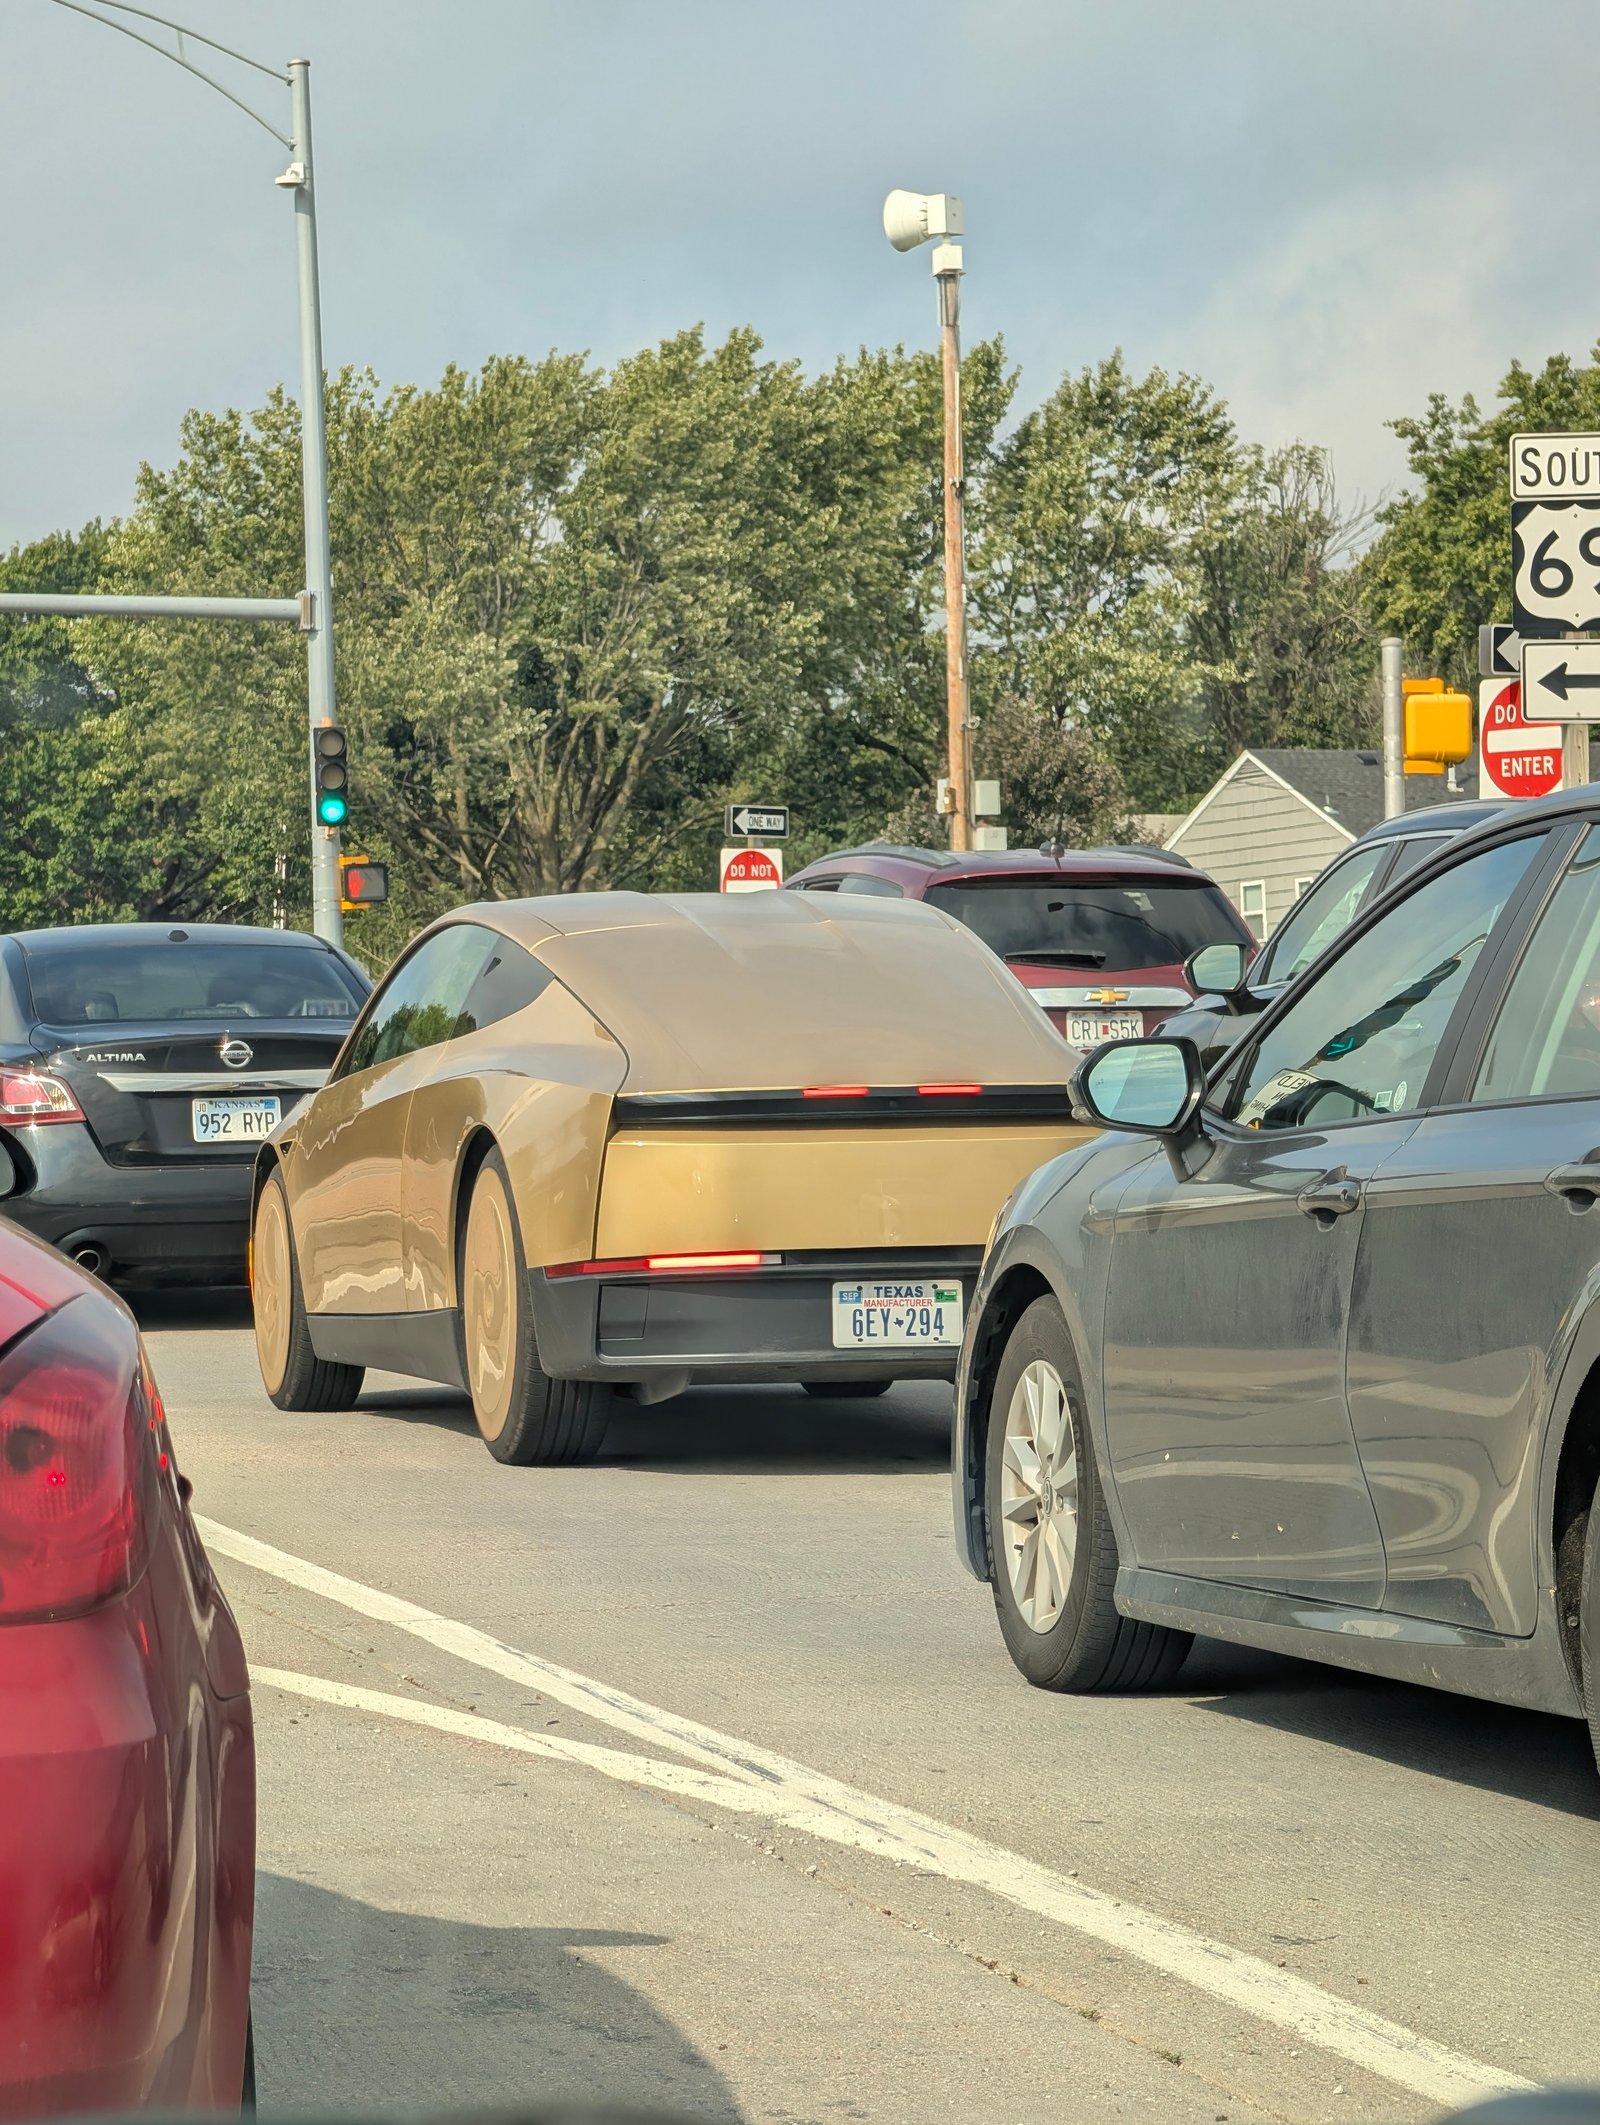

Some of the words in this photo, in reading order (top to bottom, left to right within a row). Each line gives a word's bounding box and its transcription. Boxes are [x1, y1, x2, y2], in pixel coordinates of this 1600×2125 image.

[1495, 704, 1517, 724] DO
[1501, 755, 1555, 778] ENTER
[748, 815, 764, 828] ONE
[766, 816, 782, 828] WAY
[730, 864, 746, 877] DO
[751, 864, 773, 877] NOT
[1110, 1019, 1139, 1040] S5K
[86, 1053, 147, 1063] ALTIMA
[214, 1100, 260, 1109] KANSAS
[200, 1113, 232, 1134] 952
[243, 1112, 275, 1133] RYP
[842, 1292, 859, 1301] SEP
[873, 1286, 924, 1298] TEXAS
[863, 1299, 933, 1307] MANUFACTURER
[852, 1308, 891, 1337] 6EY
[905, 1308, 944, 1337] 294
